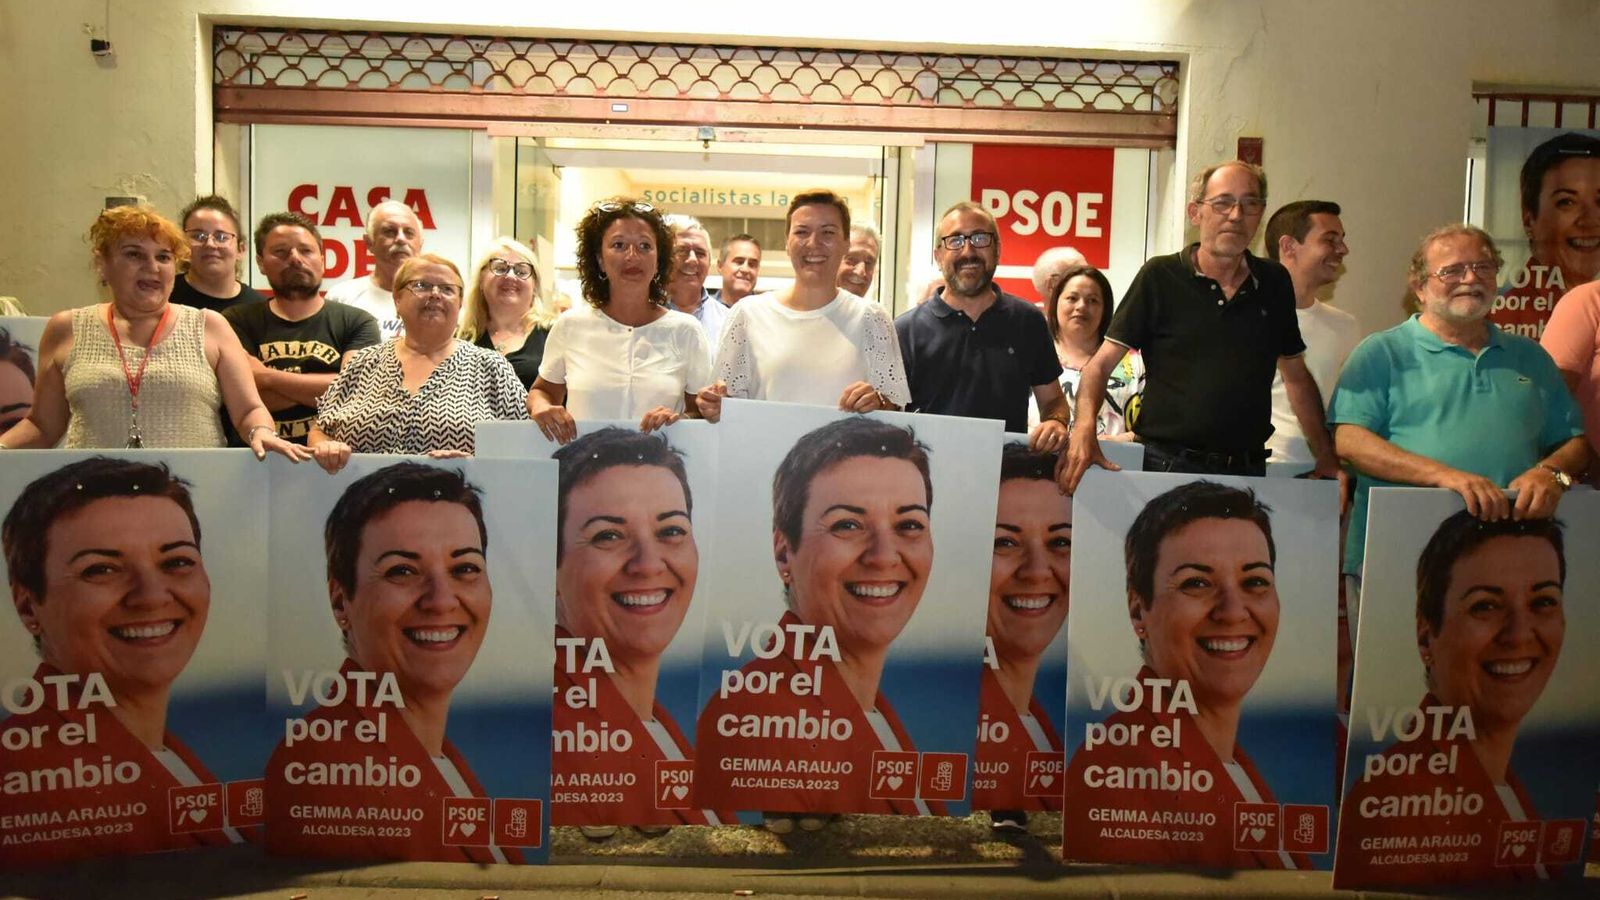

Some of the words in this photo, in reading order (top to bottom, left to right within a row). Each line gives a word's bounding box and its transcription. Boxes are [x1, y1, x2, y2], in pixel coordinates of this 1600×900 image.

[643, 187, 762, 206] socialistas
[982, 189, 1103, 238] PSOE
[1491, 295, 1530, 314] por
[1533, 292, 1553, 311] el
[258, 342, 337, 362] ALKER
[720, 621, 842, 663] VOTA
[554, 637, 616, 674] TA
[2, 672, 117, 715] OTA
[283, 670, 406, 708] VOTA
[565, 678, 597, 709] el
[720, 669, 784, 699] por
[790, 666, 823, 696] el
[1084, 676, 1199, 715] VOTA
[1, 724, 49, 751] or
[58, 714, 97, 745] el
[285, 717, 348, 747] por
[355, 712, 387, 743] el
[717, 709, 853, 741] cambio
[1085, 722, 1144, 751] por
[1150, 719, 1181, 748] el
[1366, 706, 1477, 742] VOTA
[552, 722, 633, 753] mbio
[0, 755, 141, 795] ambio
[284, 756, 422, 788] cambio
[720, 758, 782, 772] GEMMA
[785, 759, 853, 774] ARAUJO
[876, 760, 913, 775] PSOE
[1030, 761, 1063, 774] PSOE
[1364, 753, 1423, 782] por
[1428, 745, 1458, 775] el
[568, 773, 636, 786] ARAUJO
[731, 778, 804, 789] ALCALDESA
[806, 779, 840, 790] 2023
[972, 780, 997, 790] 023
[1084, 760, 1214, 793] cambio
[175, 793, 217, 811] PSOE
[590, 793, 624, 803] 2023
[1359, 787, 1484, 819] cambio
[0, 808, 62, 830] EMMA
[64, 802, 147, 822] ARAUJO
[290, 804, 352, 820] GEMMA
[356, 806, 424, 821] ARAUJO
[448, 807, 486, 821] PSOE
[1088, 808, 1148, 823] GEMMA
[1151, 810, 1216, 826] ARAUJO
[1239, 812, 1275, 827] PSOE
[2, 822, 92, 846] ALCALDESA
[94, 822, 134, 837] 2023
[302, 825, 376, 837] ALCALDESA
[377, 827, 411, 837] 2023
[1100, 828, 1170, 840] ALCALDESA
[1172, 830, 1204, 841] 2023
[1361, 836, 1421, 851] GEMMA
[1421, 834, 1482, 848] ARAUJO
[1502, 829, 1537, 844] PSOE
[1370, 854, 1436, 865] ALCALDESA
[1438, 852, 1468, 863] 2023
